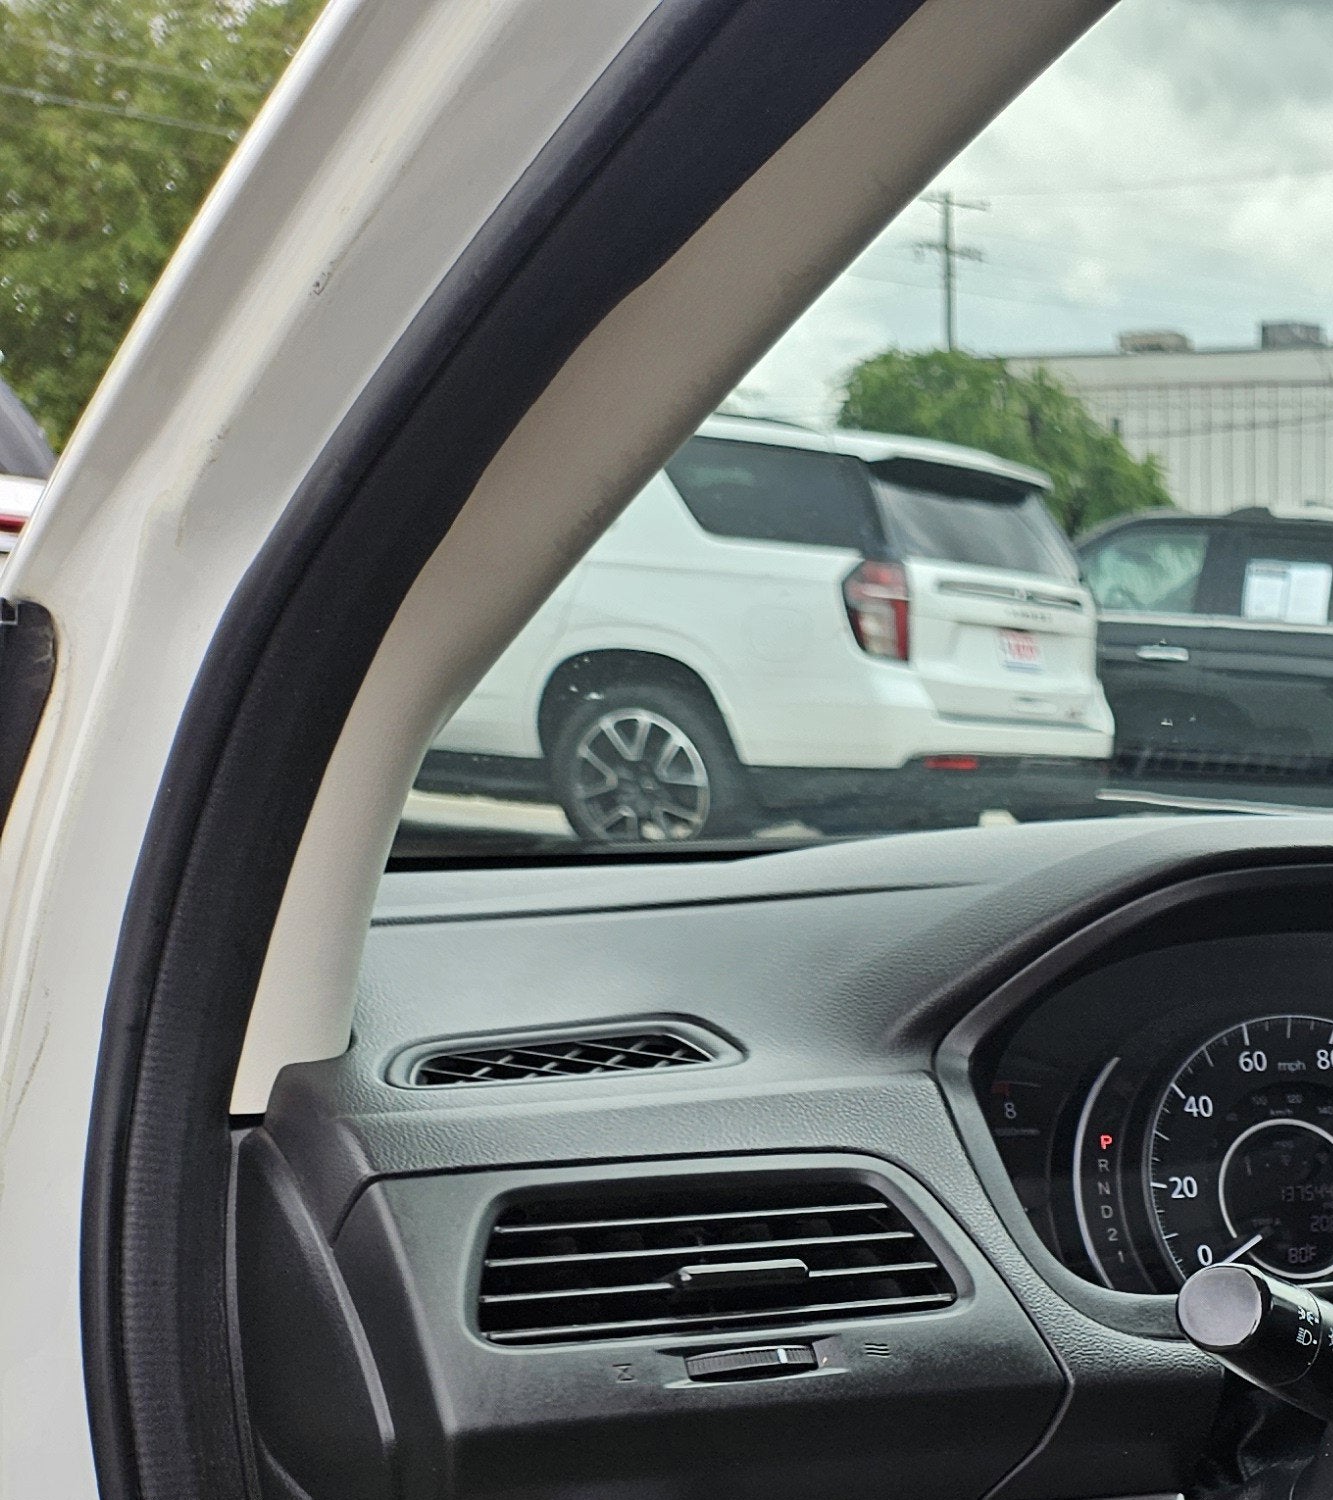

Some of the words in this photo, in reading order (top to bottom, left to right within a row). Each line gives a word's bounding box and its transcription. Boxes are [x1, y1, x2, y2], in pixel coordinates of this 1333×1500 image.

[1239, 1051, 1267, 1072] 60
[1004, 1102, 1017, 1119] 8
[1184, 1095, 1213, 1118] 40
[1100, 1134, 1113, 1150] P
[1097, 1158, 1110, 1173] R
[1097, 1181, 1111, 1196] N
[1168, 1176, 1198, 1199] 20
[1100, 1205, 1114, 1219] D
[1107, 1228, 1119, 1242] 2
[1196, 1244, 1213, 1267] 0
